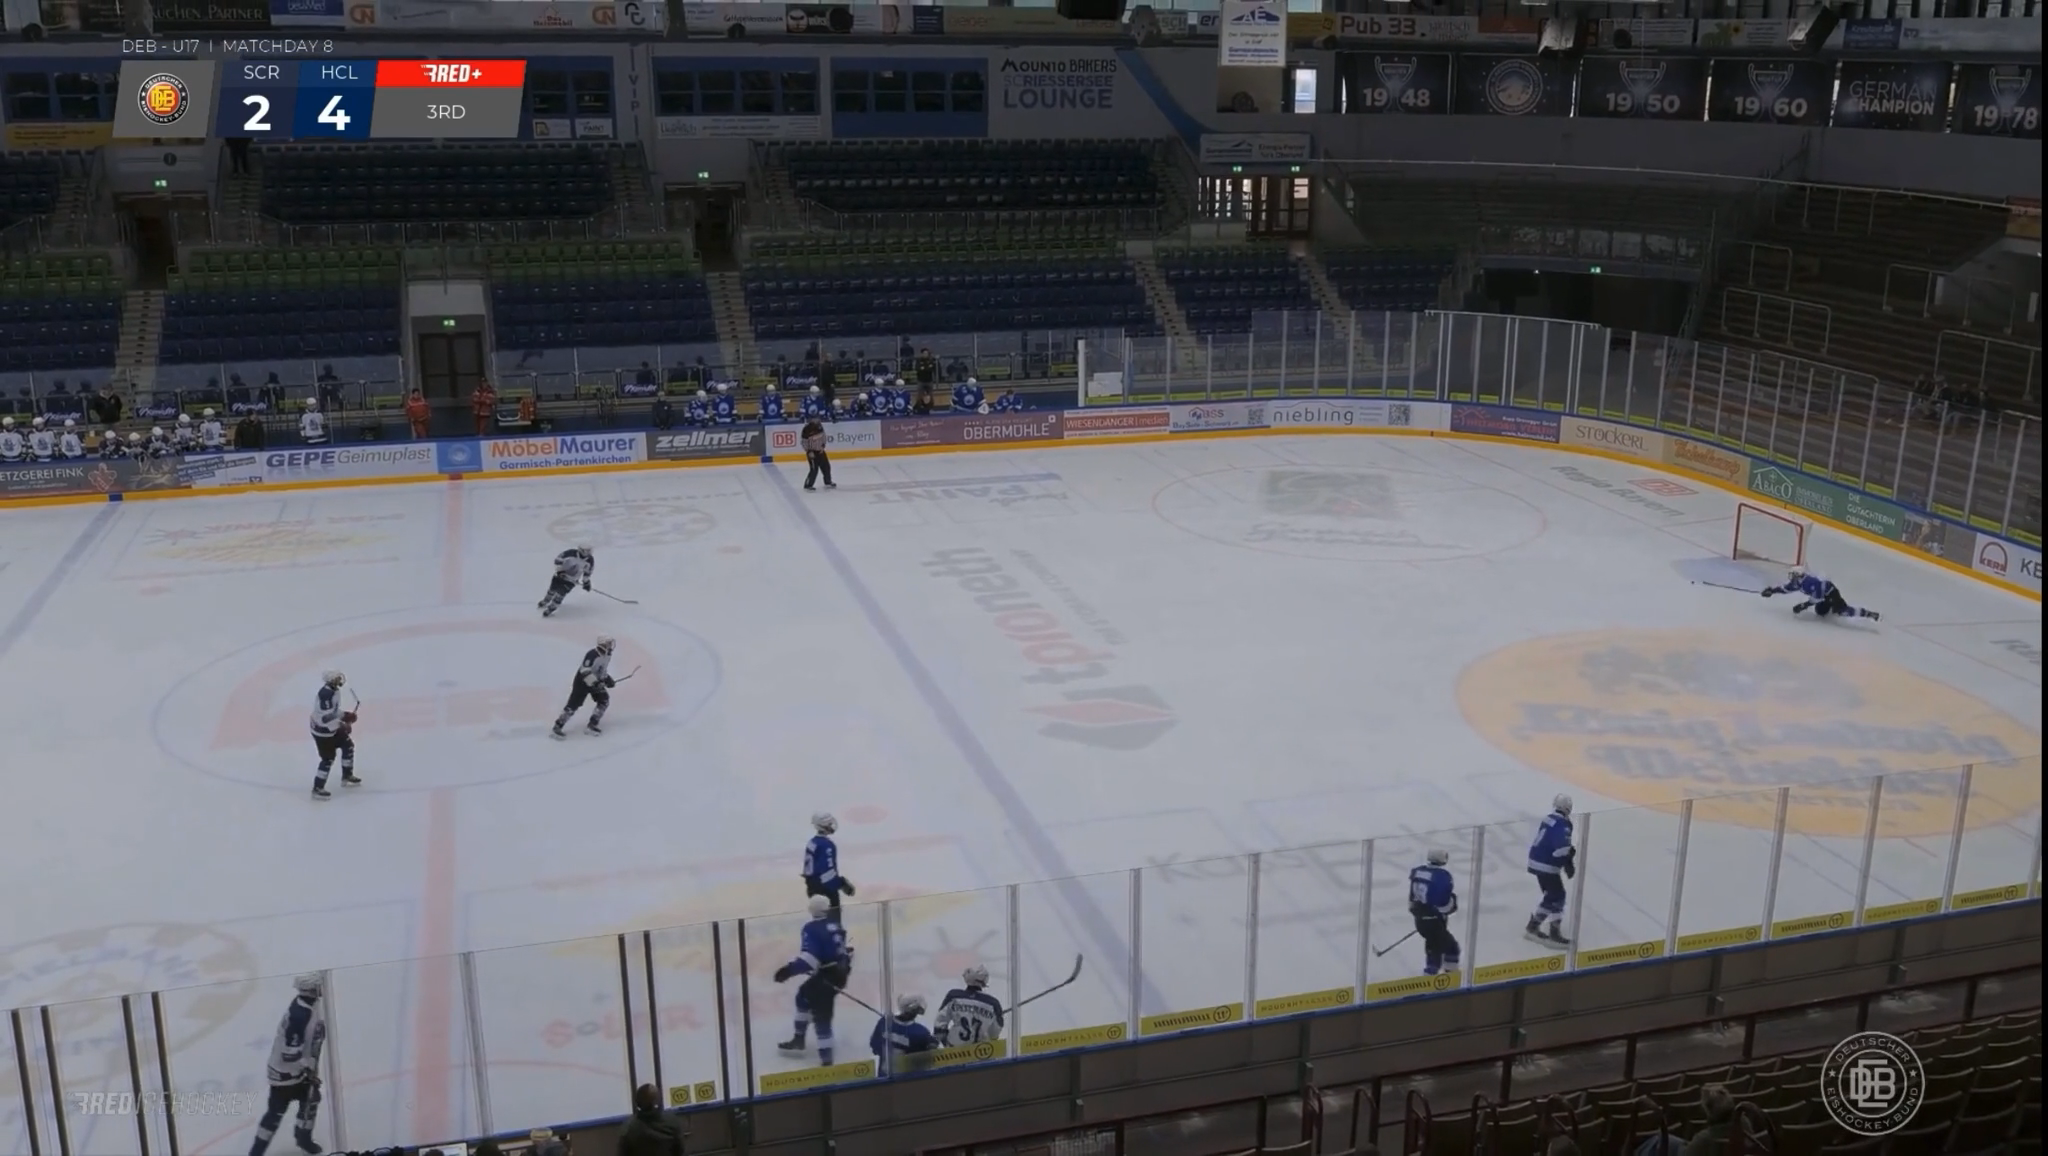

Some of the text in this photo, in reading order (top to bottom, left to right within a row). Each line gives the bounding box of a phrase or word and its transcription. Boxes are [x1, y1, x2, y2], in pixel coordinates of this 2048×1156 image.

[208, 4, 263, 19] PARTNER
[1340, 15, 1382, 34] Pub
[1388, 18, 1416, 35] 33
[1069, 58, 1117, 72] BAKERS
[1003, 89, 1113, 108] LOUNGE
[1850, 81, 1937, 101] GERMAN
[1851, 98, 1935, 116] CHAMPION
[1066, 418, 1134, 429] WIESENDANGER
[1273, 407, 1354, 425] niebling
[655, 431, 760, 448] zellmer
[774, 433, 795, 446] DB
[837, 430, 875, 445] Bayern
[491, 437, 558, 458] Möbel
[559, 437, 637, 455] Maurer
[266, 446, 432, 468] GEPE Geimuplast
[499, 454, 632, 470] Garmisch-Partenkirchen
[55, 467, 84, 479] FINK
[1848, 492, 1861, 504] DIE
[1845, 514, 1884, 534] OBERLAND
[1846, 504, 1896, 526] GUTACHTERIN
